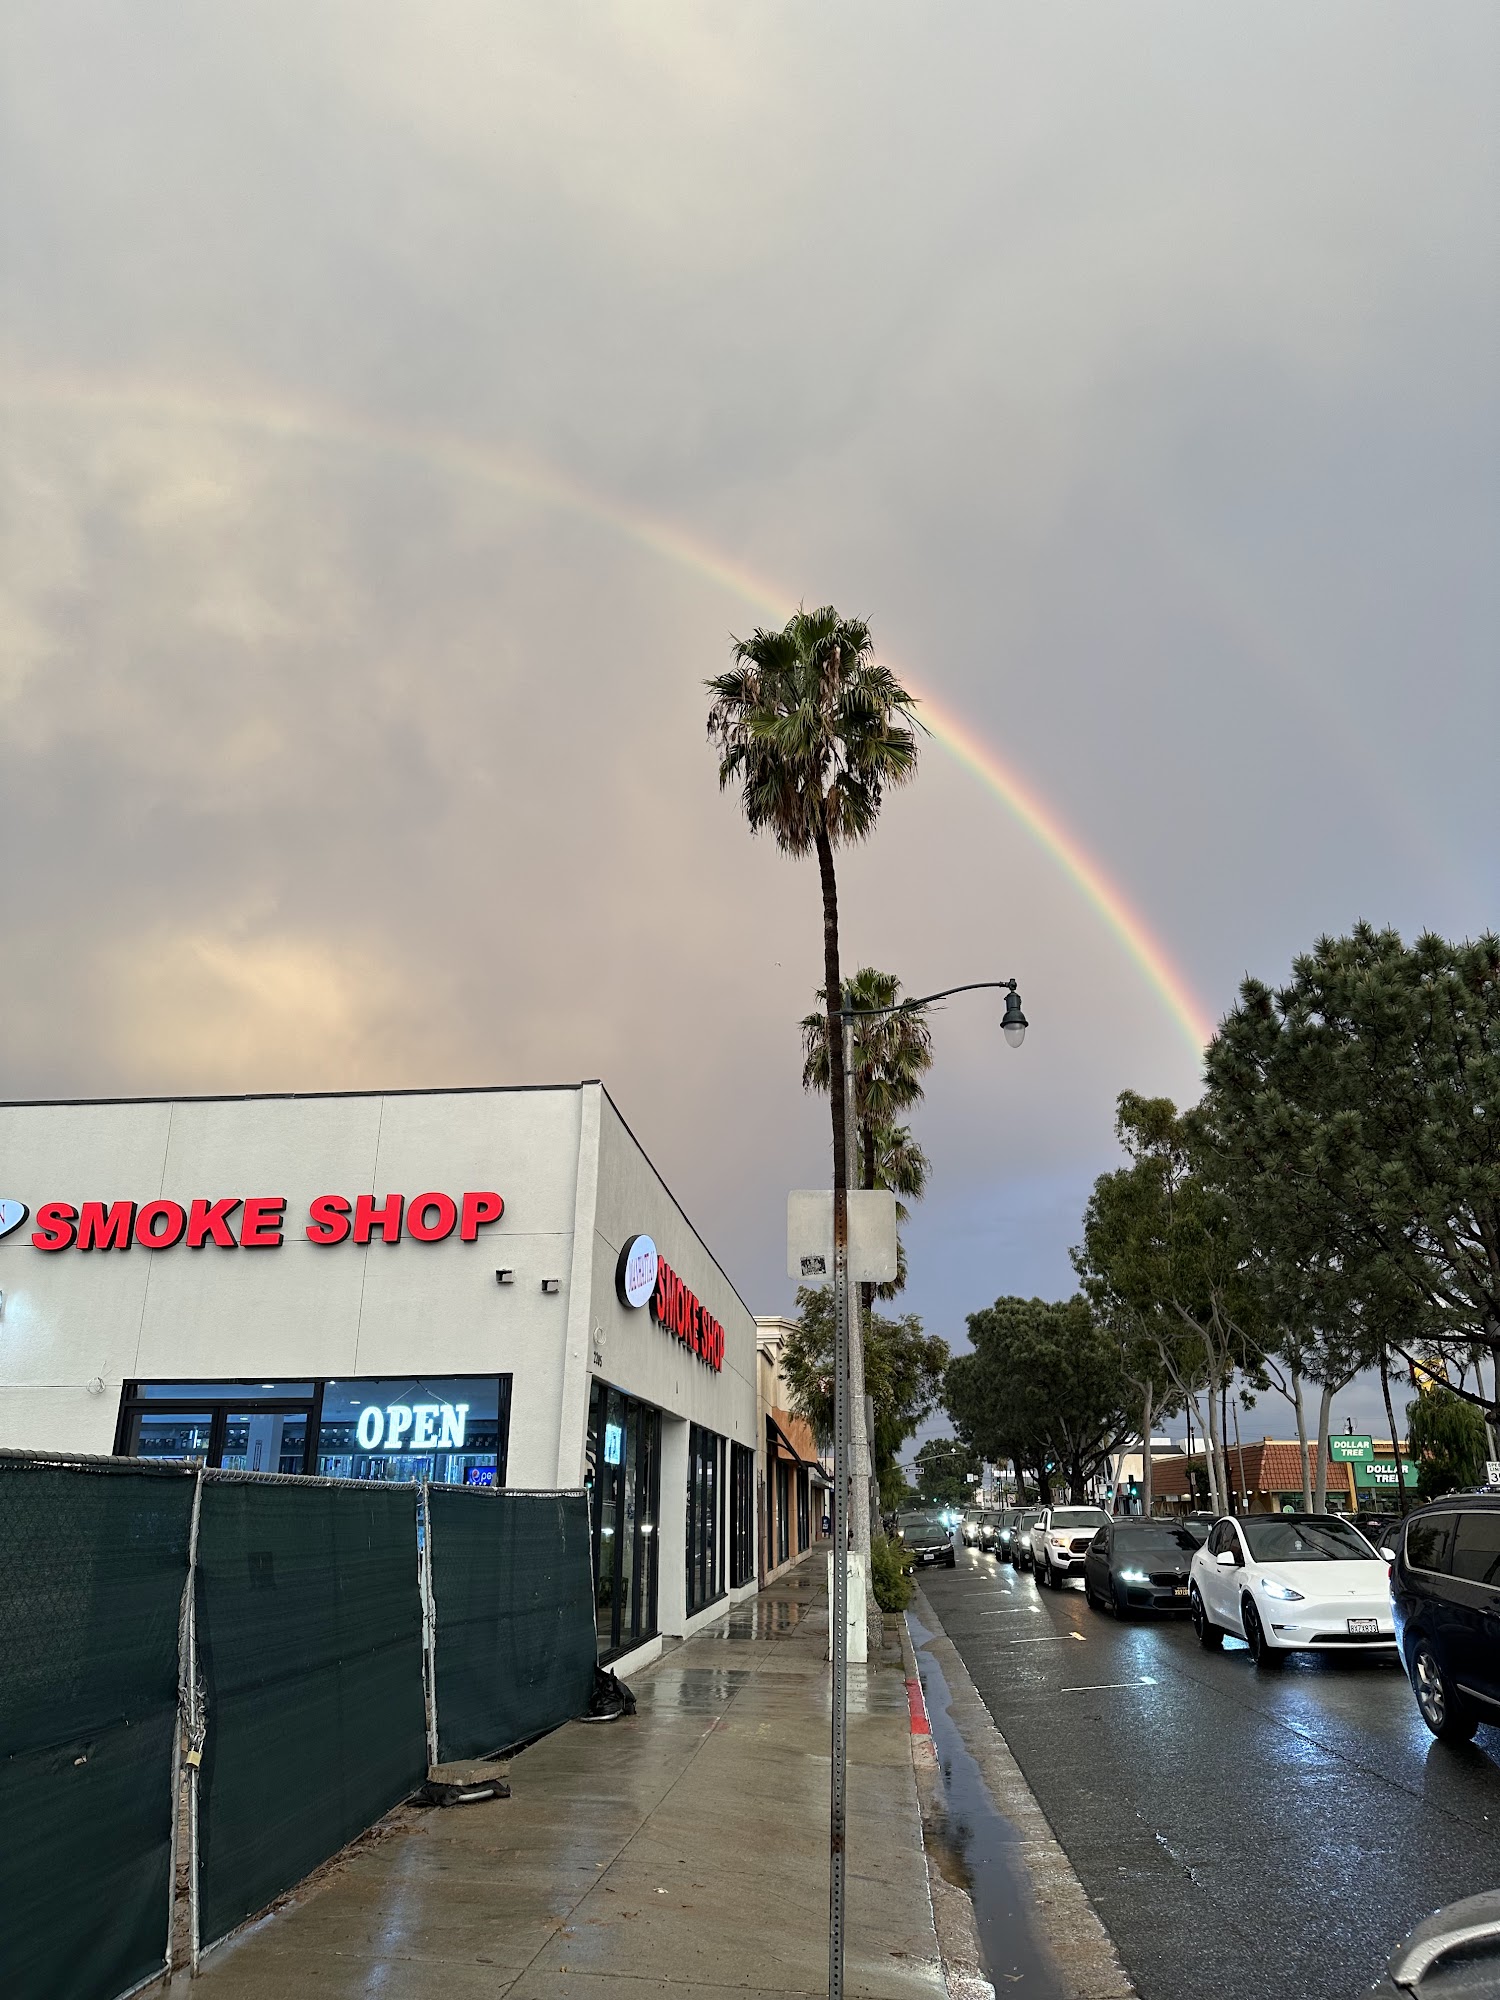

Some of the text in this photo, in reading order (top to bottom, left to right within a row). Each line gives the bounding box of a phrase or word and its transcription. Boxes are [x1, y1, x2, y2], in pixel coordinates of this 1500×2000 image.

[32, 1198, 285, 1250] SMOKE
[306, 1192, 504, 1245] SHOP
[656, 1255, 725, 1373] SMOKE SHOP
[356, 1404, 470, 1449] OPEN
[1333, 1441, 1370, 1449] DOLLAR
[1341, 1448, 1364, 1456] TREE
